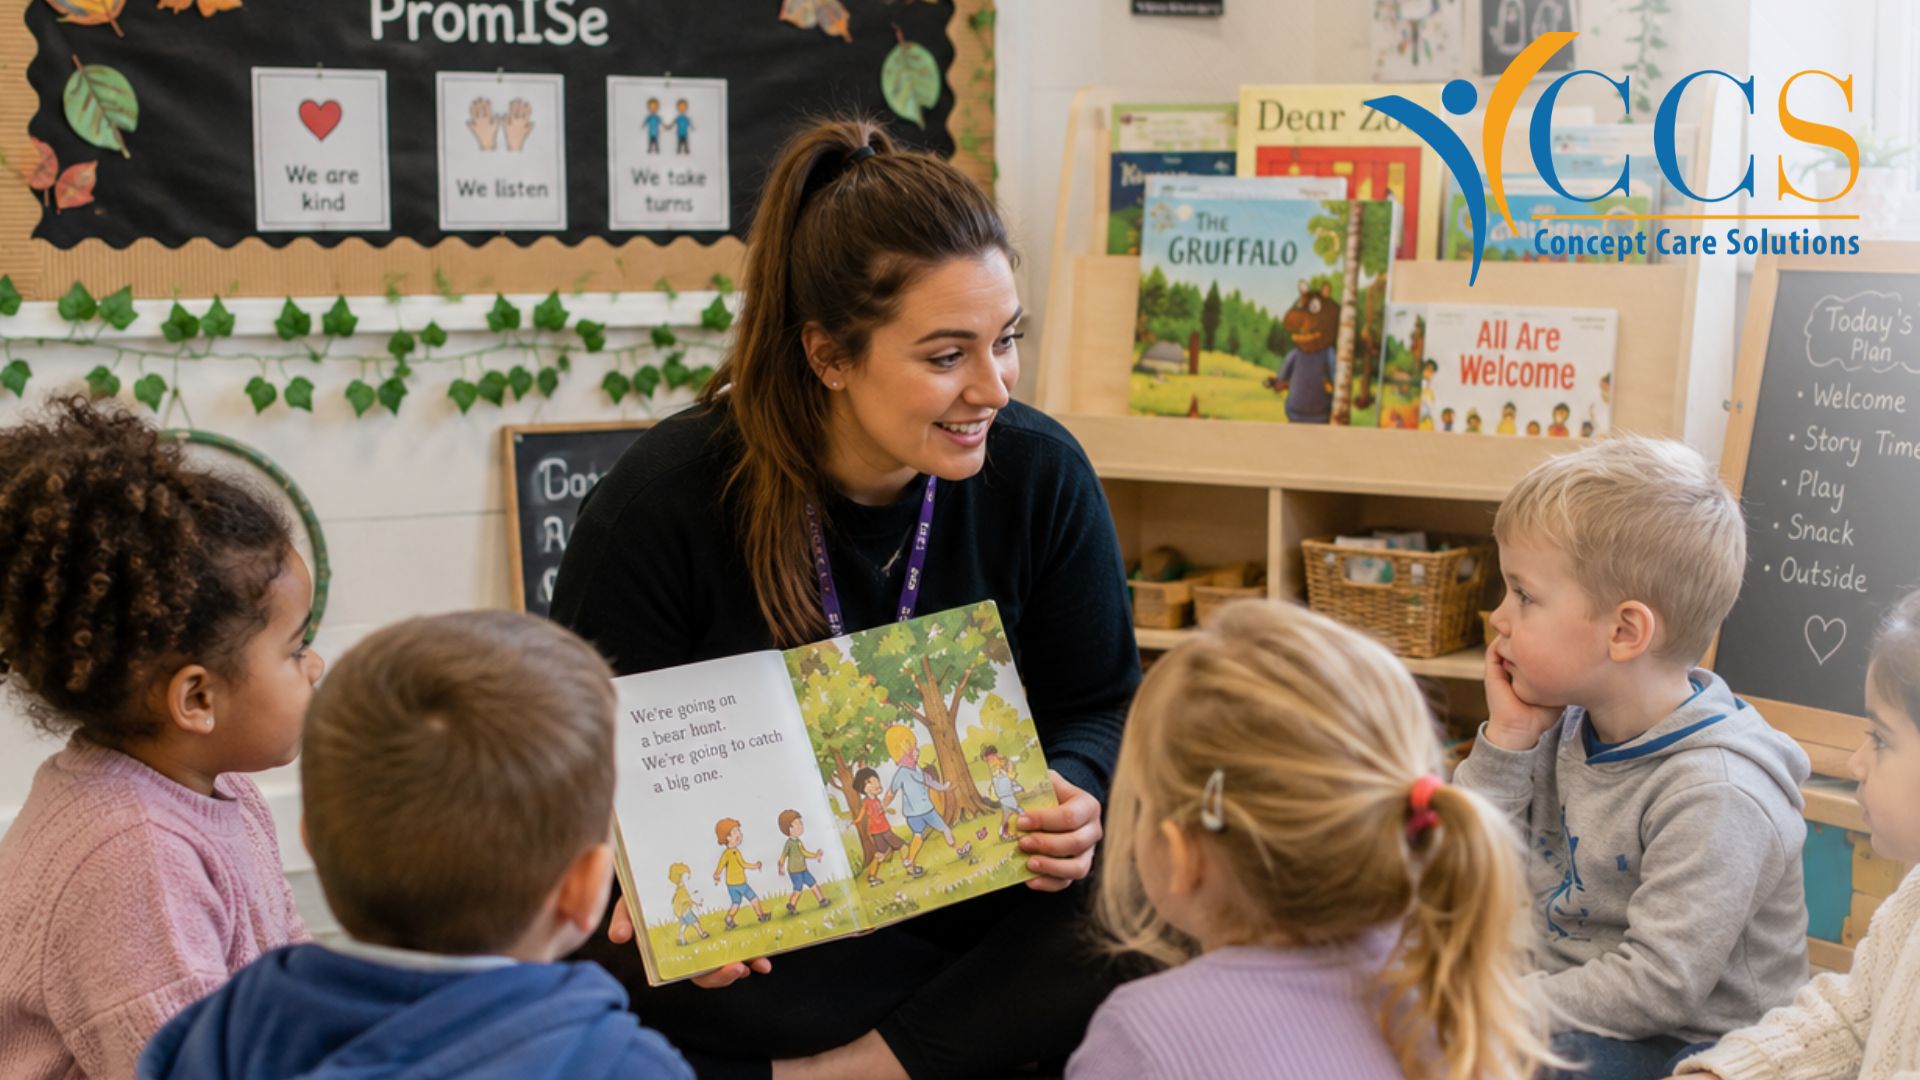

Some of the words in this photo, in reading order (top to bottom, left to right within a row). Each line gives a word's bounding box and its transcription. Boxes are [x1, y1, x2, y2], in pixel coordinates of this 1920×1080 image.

[370, 0, 609, 46] PromISe
[1257, 99, 1345, 132] Dear
[1359, 99, 1403, 132] Zo
[285, 164, 318, 184] We
[326, 167, 360, 185] are
[456, 178, 487, 198] We
[494, 180, 549, 198] listen
[631, 166, 660, 187] We
[667, 168, 707, 187] take
[302, 193, 346, 212] kind
[645, 195, 694, 213] turns
[1196, 211, 1231, 233] THE
[1168, 235, 1298, 267] GRUFFALO
[1476, 320, 1509, 350] All
[1516, 322, 1561, 352] Are
[1825, 306, 1914, 342] Today's
[1851, 337, 1892, 362] Plan
[1460, 353, 1576, 390] Welcome
[1813, 382, 1907, 414] Welcome
[1804, 425, 1862, 468] Story
[1875, 430, 1920, 460] Time
[1797, 469, 1846, 514] Play
[1787, 513, 1855, 547] Snack
[1780, 556, 1868, 593] Outside
[630, 708, 674, 724] We're
[677, 699, 717, 720] going
[719, 694, 737, 707] on
[641, 736, 651, 748] a
[653, 728, 687, 746] bear
[690, 719, 727, 738] hunt.
[641, 751, 686, 771] We're
[689, 742, 729, 765] going
[731, 738, 746, 753] to
[748, 729, 784, 749] catch
[653, 782, 664, 794] a
[666, 773, 691, 792] big
[693, 768, 724, 785] one.
